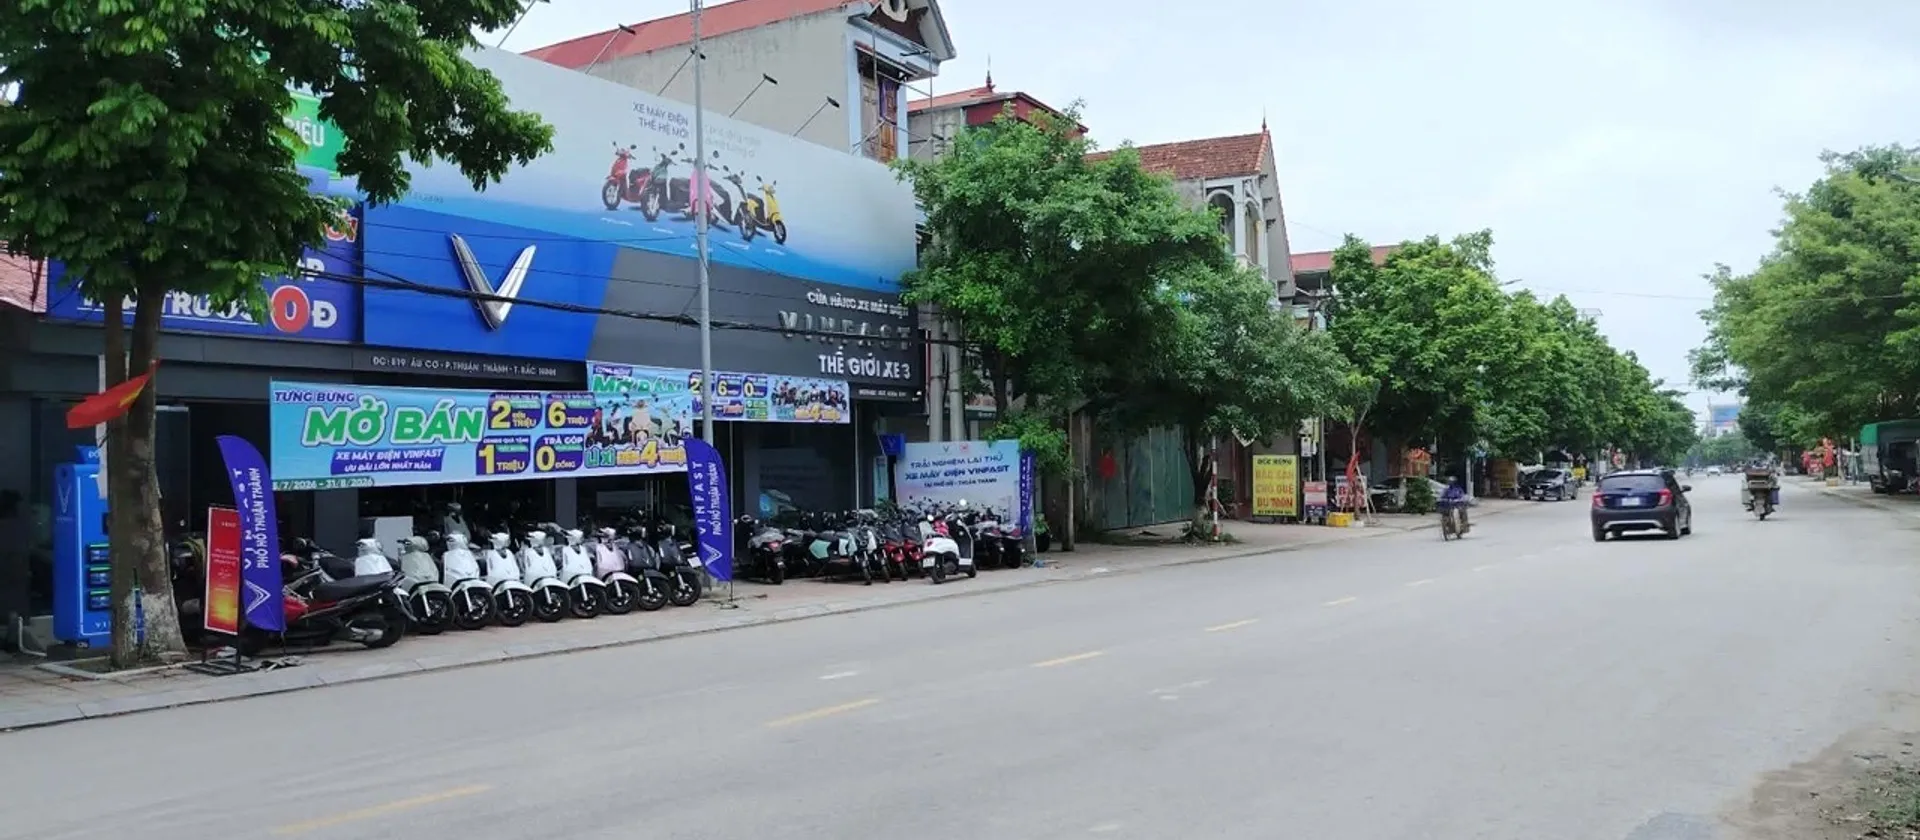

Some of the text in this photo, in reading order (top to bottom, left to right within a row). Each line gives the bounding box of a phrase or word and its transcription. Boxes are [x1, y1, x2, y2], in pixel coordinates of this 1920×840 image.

[632, 102, 645, 114] XE
[807, 288, 828, 305] CỬA
[829, 292, 857, 309] HÀNG
[857, 300, 870, 311] XE
[778, 309, 911, 350] VINFAST
[818, 345, 911, 379] THẾ GIỚI XE 3
[274, 391, 313, 403] TƯNG
[690, 378, 702, 394] 2
[717, 381, 727, 395] 6
[744, 382, 755, 397] 0
[303, 396, 486, 445] MỞ BÁN
[491, 400, 511, 429] 2
[512, 417, 537, 429] TRIỆU
[548, 401, 567, 427] 6
[567, 415, 588, 426] TRIỆU
[543, 435, 583, 444] TRẢ GÓP
[335, 448, 443, 461] XE MÁY ĐIỆN VINFAST
[479, 444, 525, 474] 1 TRIỆU
[536, 445, 555, 471] 0
[640, 439, 657, 467] 4
[910, 458, 931, 469] TRẢI
[248, 467, 264, 499] THÀNH
[905, 464, 1010, 480] XE MÁY ĐIỆN VINFAST
[692, 461, 707, 535] VINFAST
[250, 500, 268, 532] THUẬN
[252, 548, 269, 569] PHỐ
